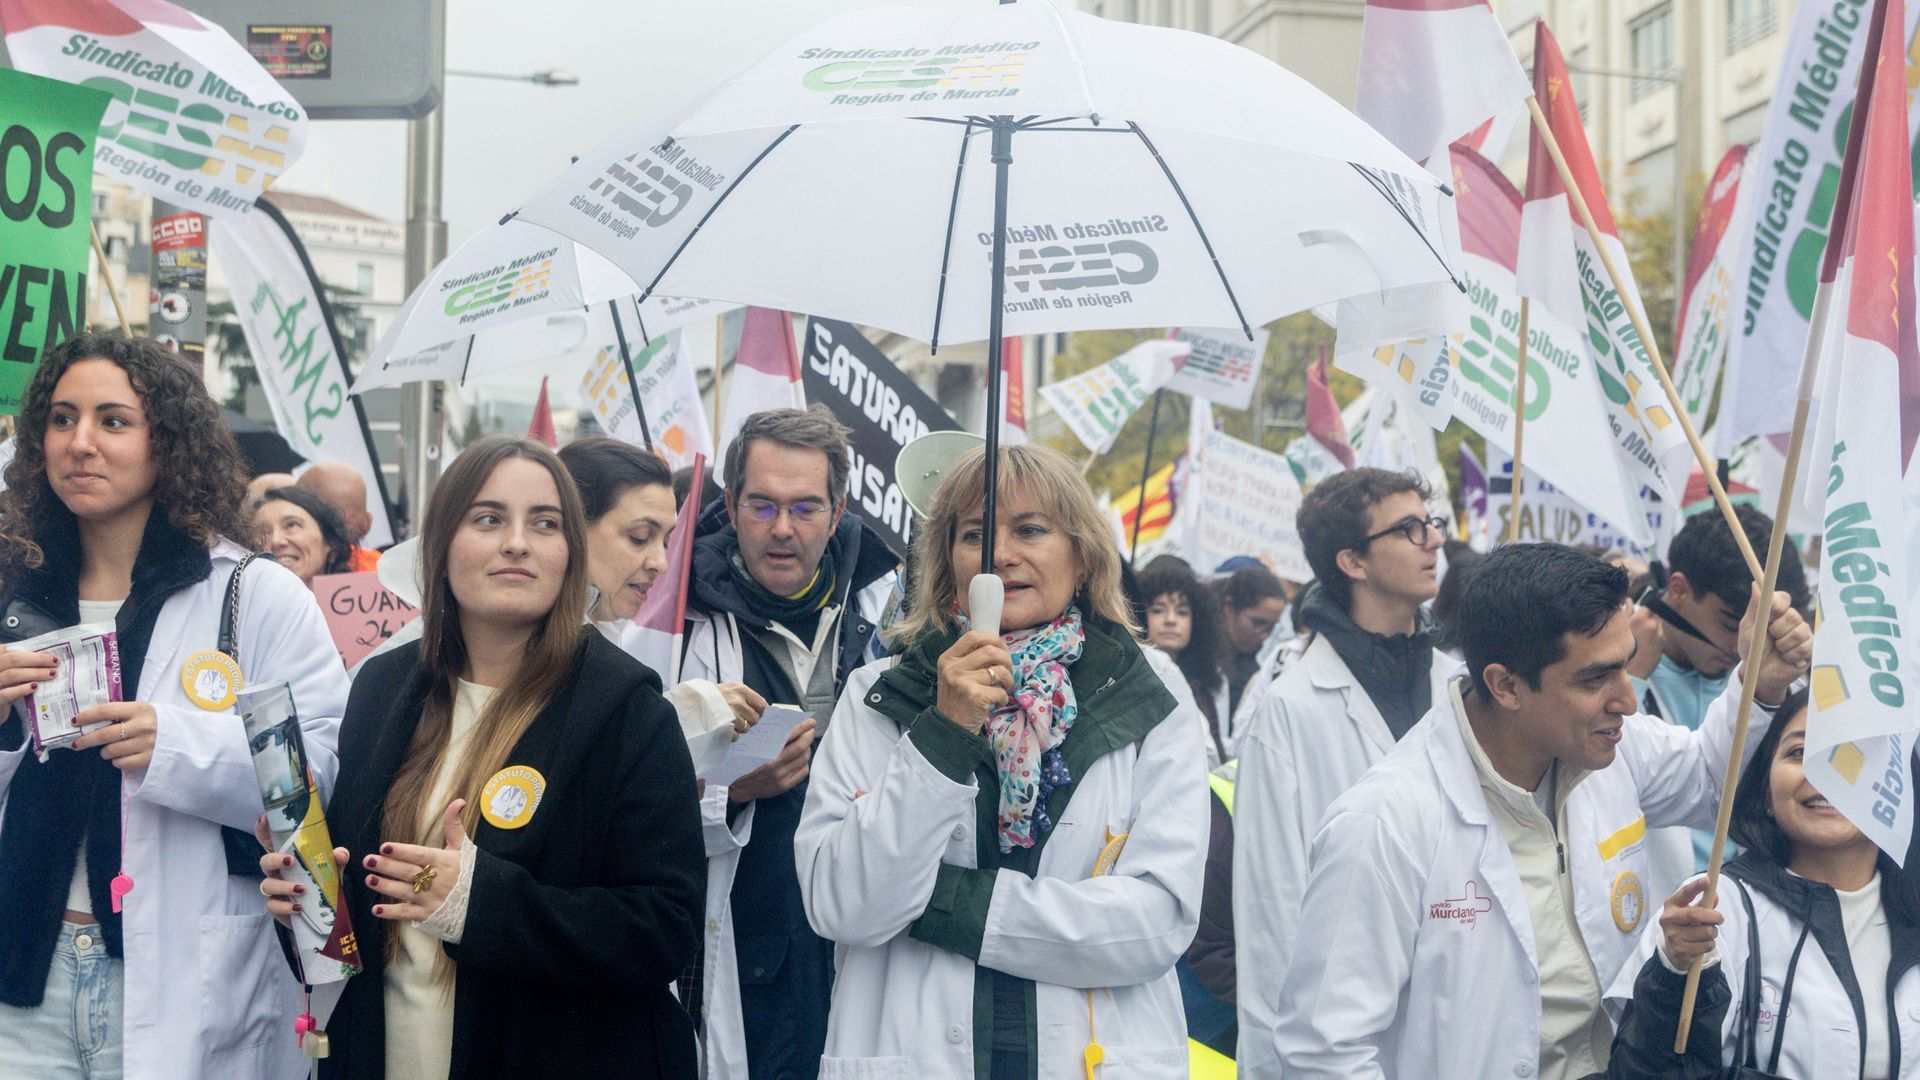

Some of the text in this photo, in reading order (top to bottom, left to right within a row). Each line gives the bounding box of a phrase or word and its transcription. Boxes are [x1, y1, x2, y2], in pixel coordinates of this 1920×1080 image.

[62, 34, 194, 88] Sindicato
[798, 41, 1041, 59] Sindicato Médico
[802, 53, 1029, 92] CESM
[830, 88, 1020, 106] Región de Murcia
[96, 146, 171, 186] Región
[174, 179, 203, 198] de
[440, 247, 559, 292] Sindicato Médico
[459, 290, 549, 325] Región de Murcia
[1496, 503, 1582, 544] SALUD
[1824, 501, 1905, 708] Médico
[109, 640, 121, 684] SERRANO
[185, 654, 241, 694] ESTATUTO PROPIO
[485, 770, 543, 813] ESTATUTO PROPIO
[1429, 907, 1475, 920] Murciano
